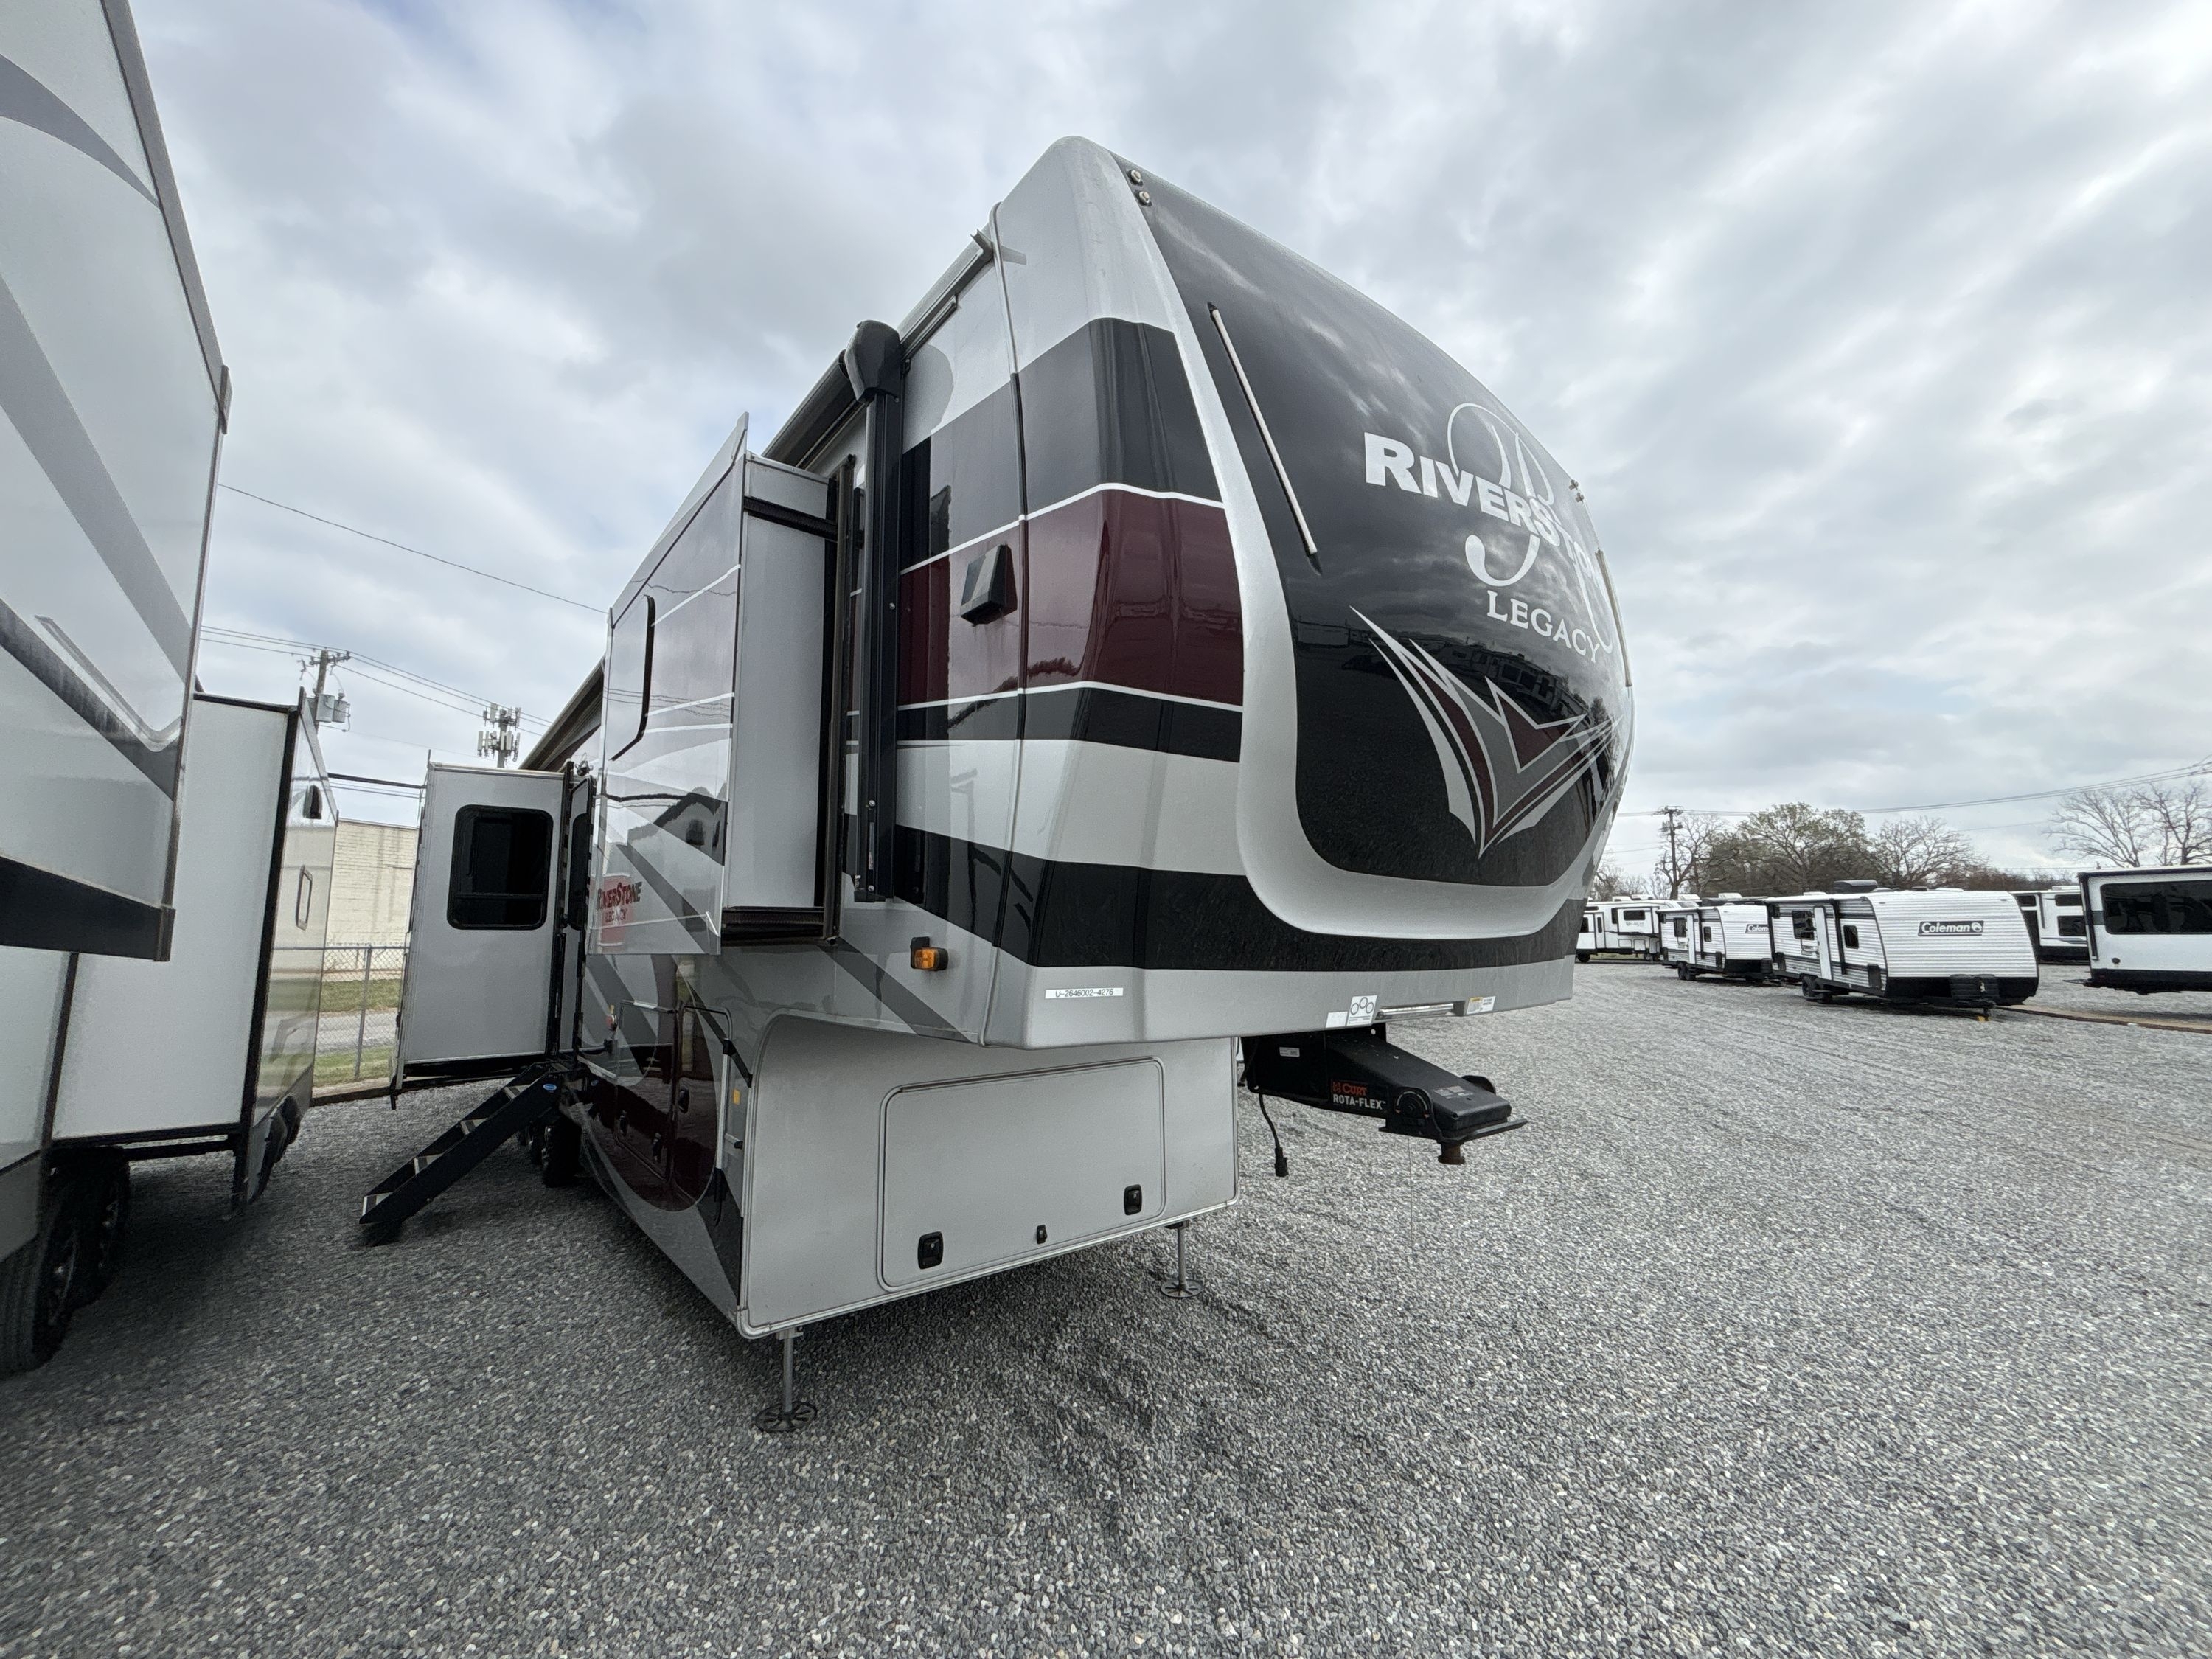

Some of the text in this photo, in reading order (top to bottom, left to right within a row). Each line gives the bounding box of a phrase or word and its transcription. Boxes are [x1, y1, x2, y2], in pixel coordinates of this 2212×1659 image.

[1364, 432, 1604, 591] RIVERSTO
[1486, 590, 1600, 663] LEGACY
[1921, 922, 1971, 933] Coleman
[1055, 988, 1114, 998] U-2646002-4276
[1342, 1083, 1367, 1096] CURT
